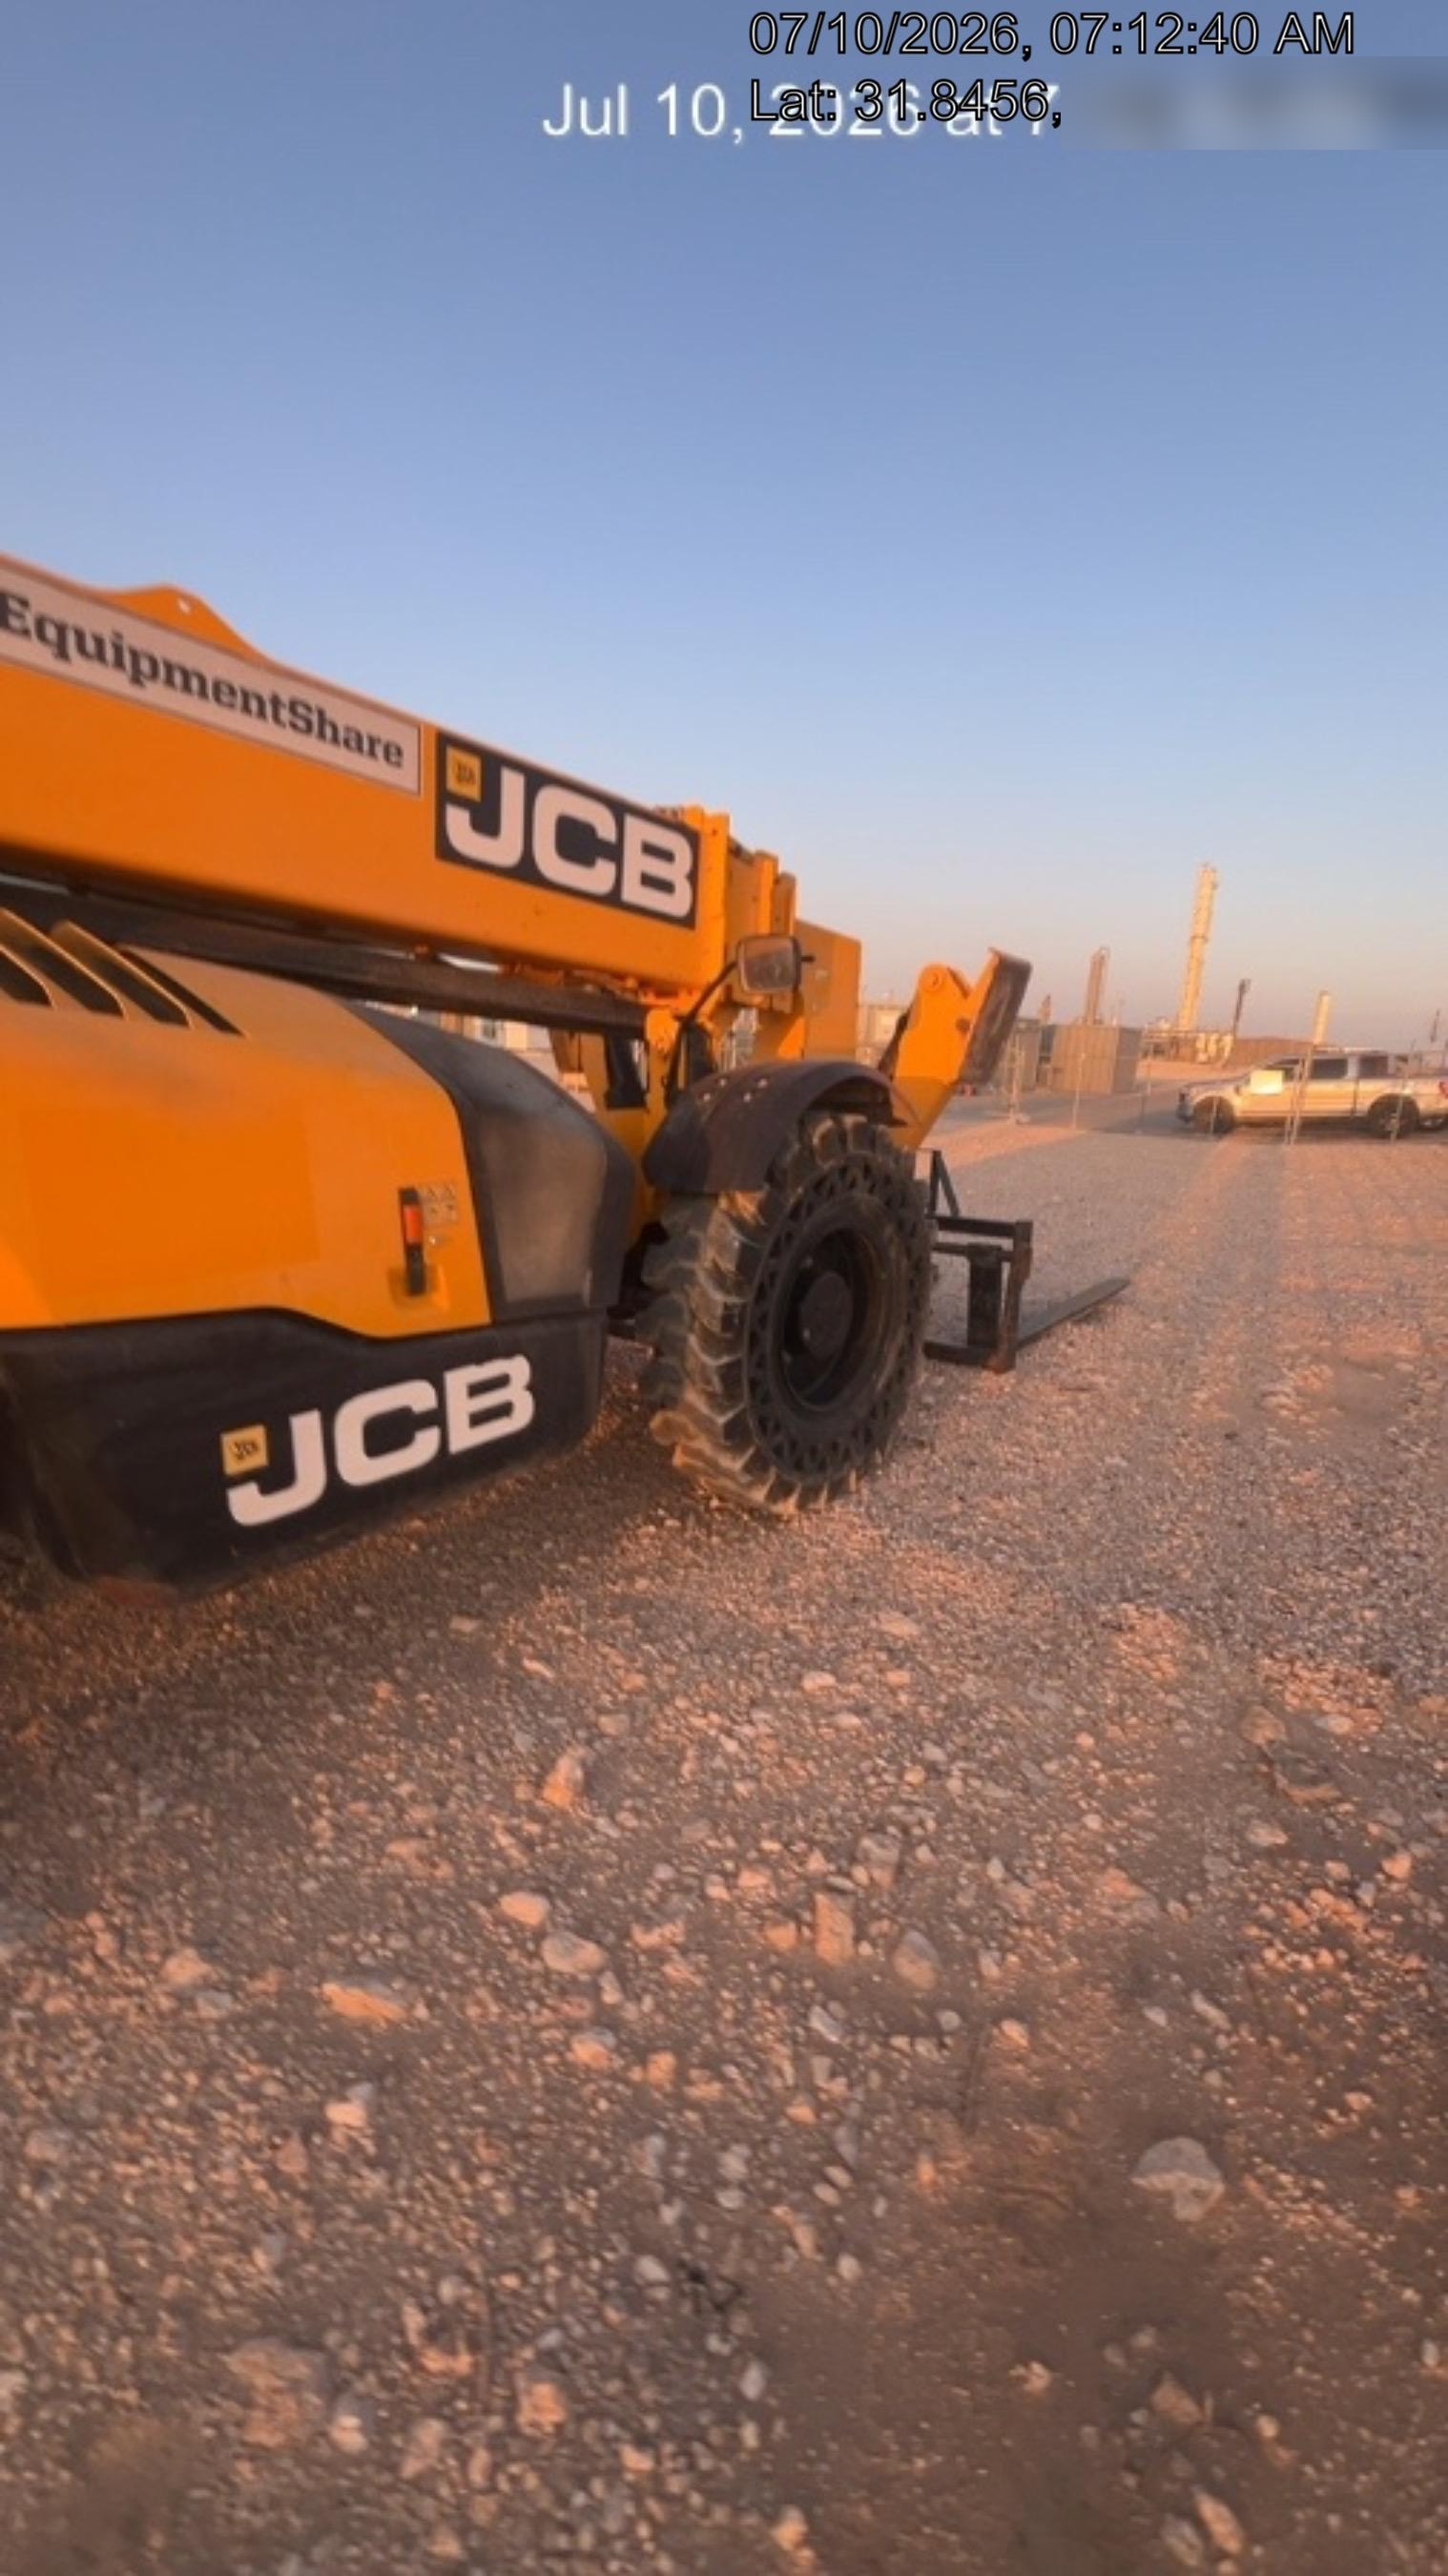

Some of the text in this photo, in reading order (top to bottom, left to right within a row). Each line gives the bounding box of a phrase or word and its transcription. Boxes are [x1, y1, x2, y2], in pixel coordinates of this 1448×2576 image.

[0, 591, 404, 769] EquipmentShare
[445, 764, 694, 919] JCB
[226, 1354, 535, 1527] JCB
